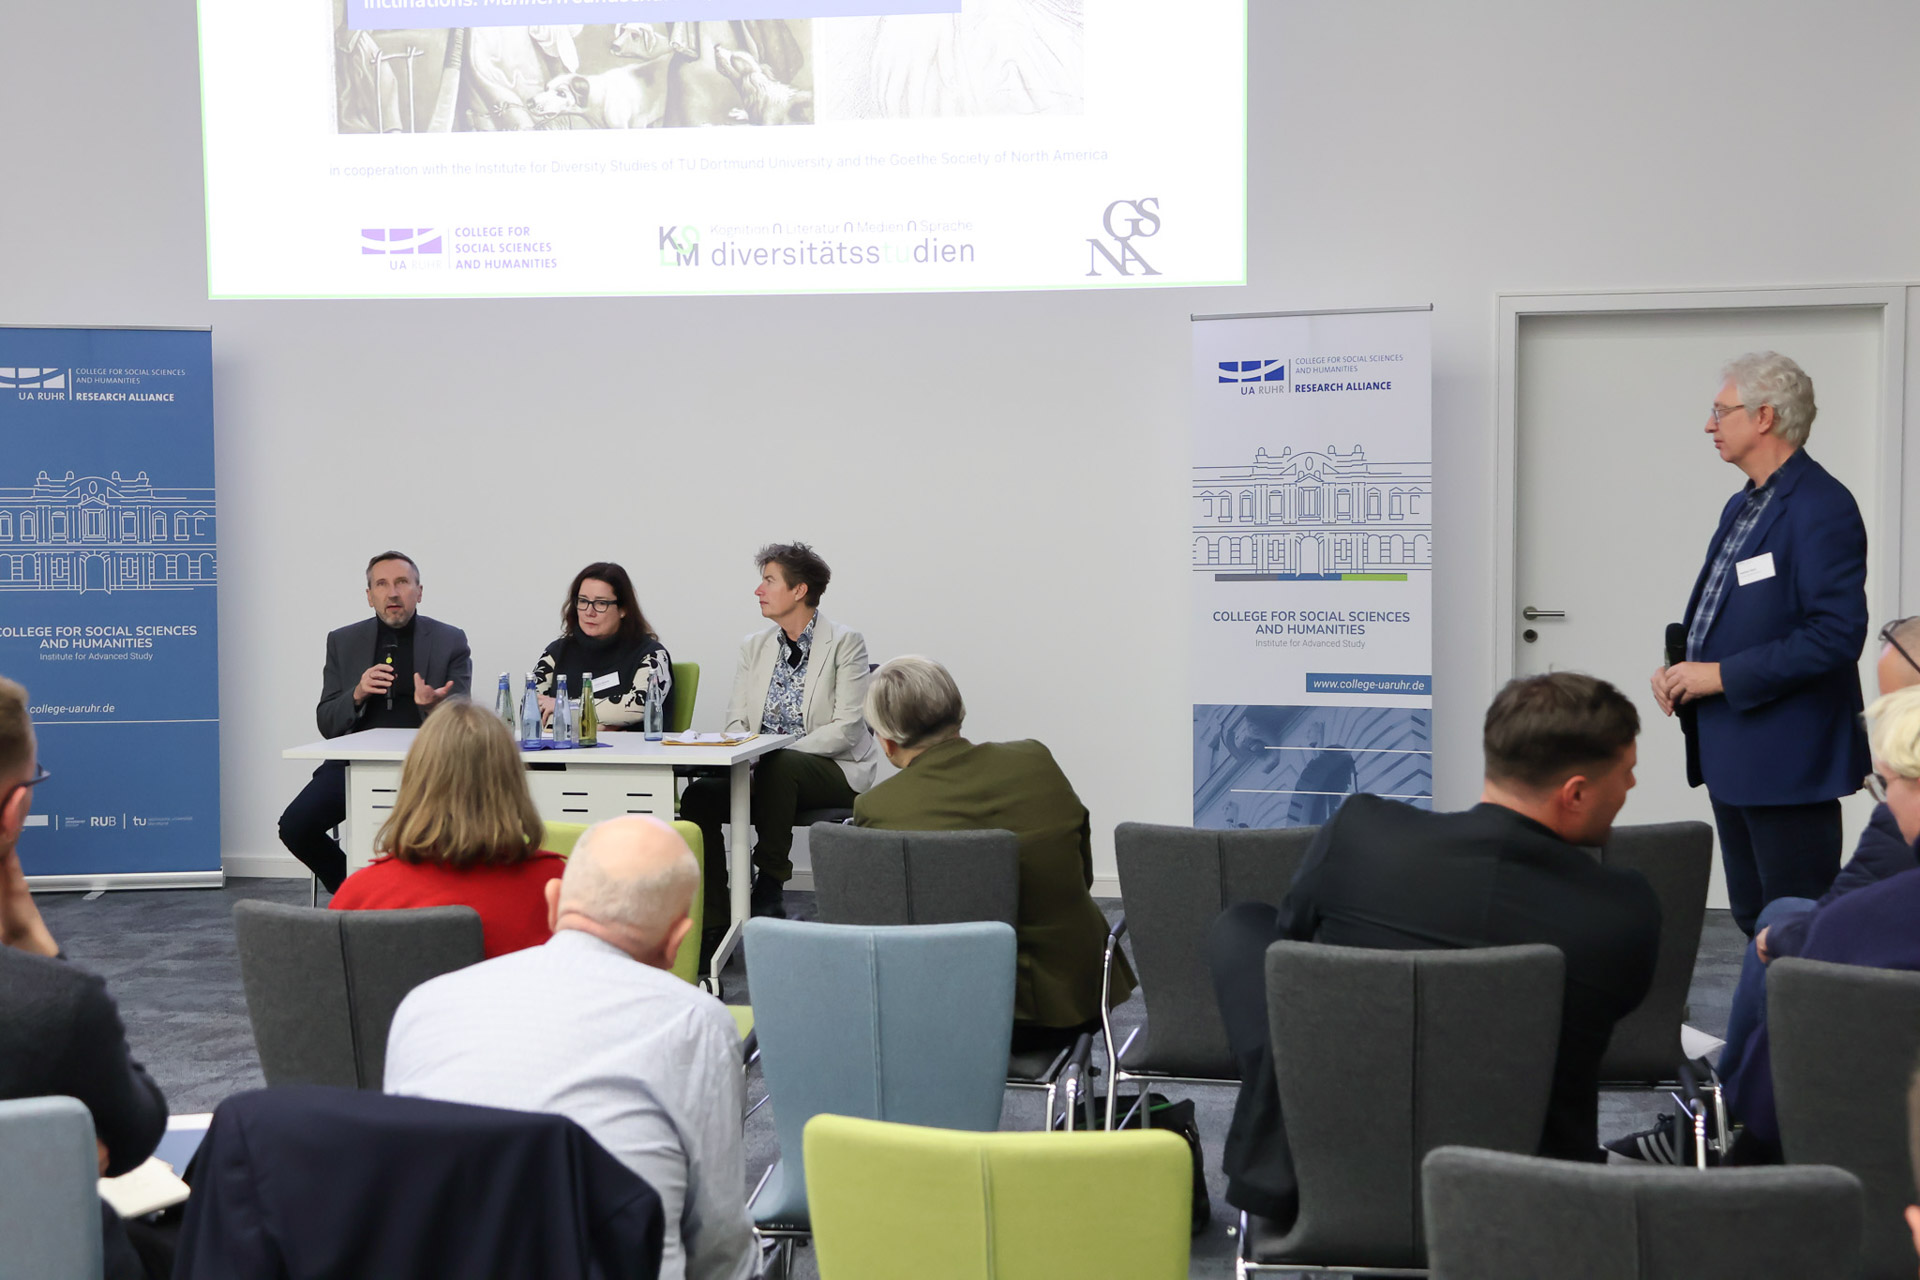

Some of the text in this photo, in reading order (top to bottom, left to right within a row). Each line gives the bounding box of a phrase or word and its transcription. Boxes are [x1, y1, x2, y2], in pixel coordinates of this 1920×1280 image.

[329, 149, 1108, 179] in cooperation with the Institute for Diversity Studies of TU Dortmund University and the Goethe Society of North America
[454, 226, 529, 238] COLLEGE FOR
[710, 219, 972, 239] Kognition Literatur Medien Sprache
[455, 242, 551, 254] SOCIAL SCIENCES
[711, 237, 974, 267] diversitätsstudien
[389, 259, 441, 271] UA RUHR
[455, 258, 557, 270] AND HUMANITIES
[1295, 353, 1403, 366] COLLEGE FOR SOCIAL SCIENCES
[75, 367, 106, 375] COLLEGE
[124, 368, 149, 376] SOCIAL
[151, 368, 185, 376] SCIENCES
[1295, 365, 1358, 374] AND HUMANITIES
[75, 376, 140, 385] AND HUMANITIES
[1240, 384, 1284, 396] UA RUHR
[1294, 381, 1391, 393] RESEARCH ALLIANCE
[18, 391, 64, 401] UA RUHR
[76, 392, 174, 402] RESEARCH ALLIANCE
[1212, 610, 1410, 623] COLLEGE FOR SOCIAL SCIENCES
[55, 626, 81, 637] FOR
[85, 626, 132, 637] SOCIAL
[135, 625, 198, 637] SCIENCES
[1255, 623, 1365, 635] AND HUMANITIES
[39, 637, 152, 649] AND HUMANITIES
[1255, 638, 1365, 650] Institute for Advanced Study
[39, 651, 153, 662] Institute for Advanced Study
[1313, 679, 1425, 692] www.college-uaruhr.de
[29, 703, 115, 716] college-uaruhr.de
[90, 816, 116, 827] RUB
[132, 815, 146, 826] tu
